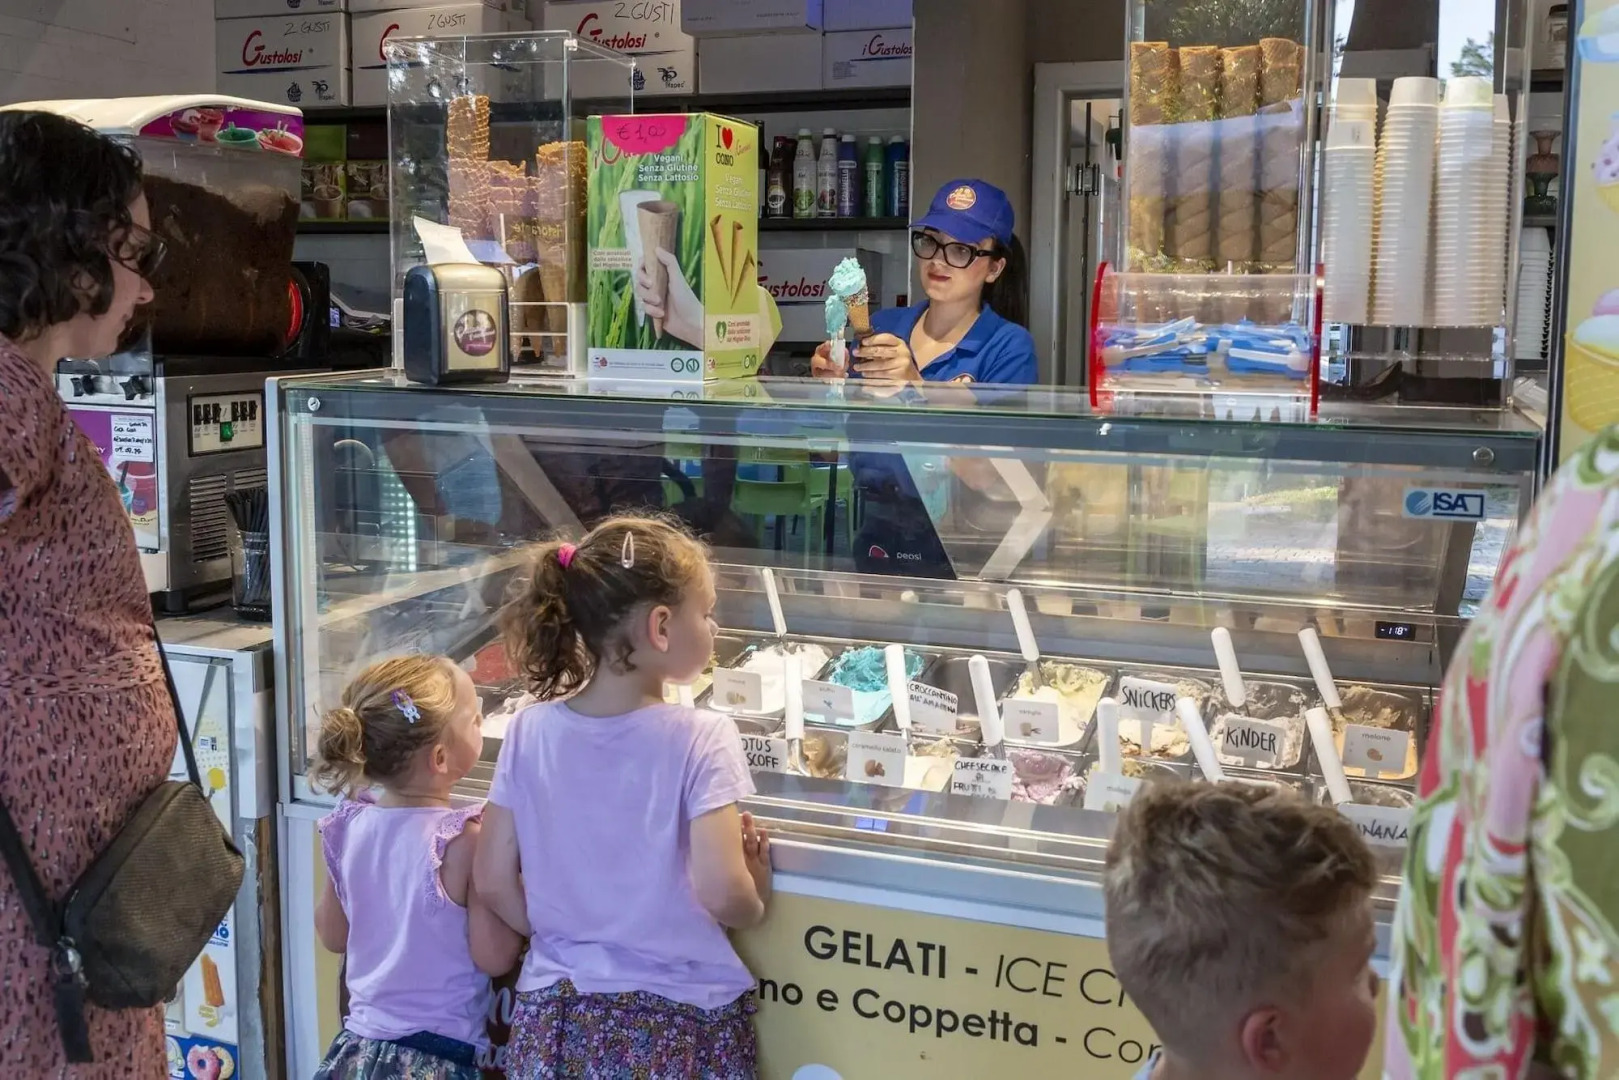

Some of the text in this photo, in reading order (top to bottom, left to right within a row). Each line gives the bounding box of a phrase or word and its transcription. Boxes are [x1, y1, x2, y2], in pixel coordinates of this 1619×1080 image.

[614, 1, 674, 25] 2 GUSTI
[283, 23, 297, 36] 2
[242, 30, 303, 66] Gustolosi
[653, 154, 683, 163] Vegani
[638, 163, 698, 172] Senza Glutine
[638, 173, 699, 182] Senza Lattosio
[1433, 492, 1469, 512] ISA
[740, 737, 772, 753] OTUS
[746, 752, 779, 769] SCOFF
[804, 925, 947, 979] GELATI
[995, 954, 1068, 998] ICE
[759, 977, 803, 1006] no
[816, 988, 839, 1012] e
[852, 987, 1039, 1048] Coppetta
